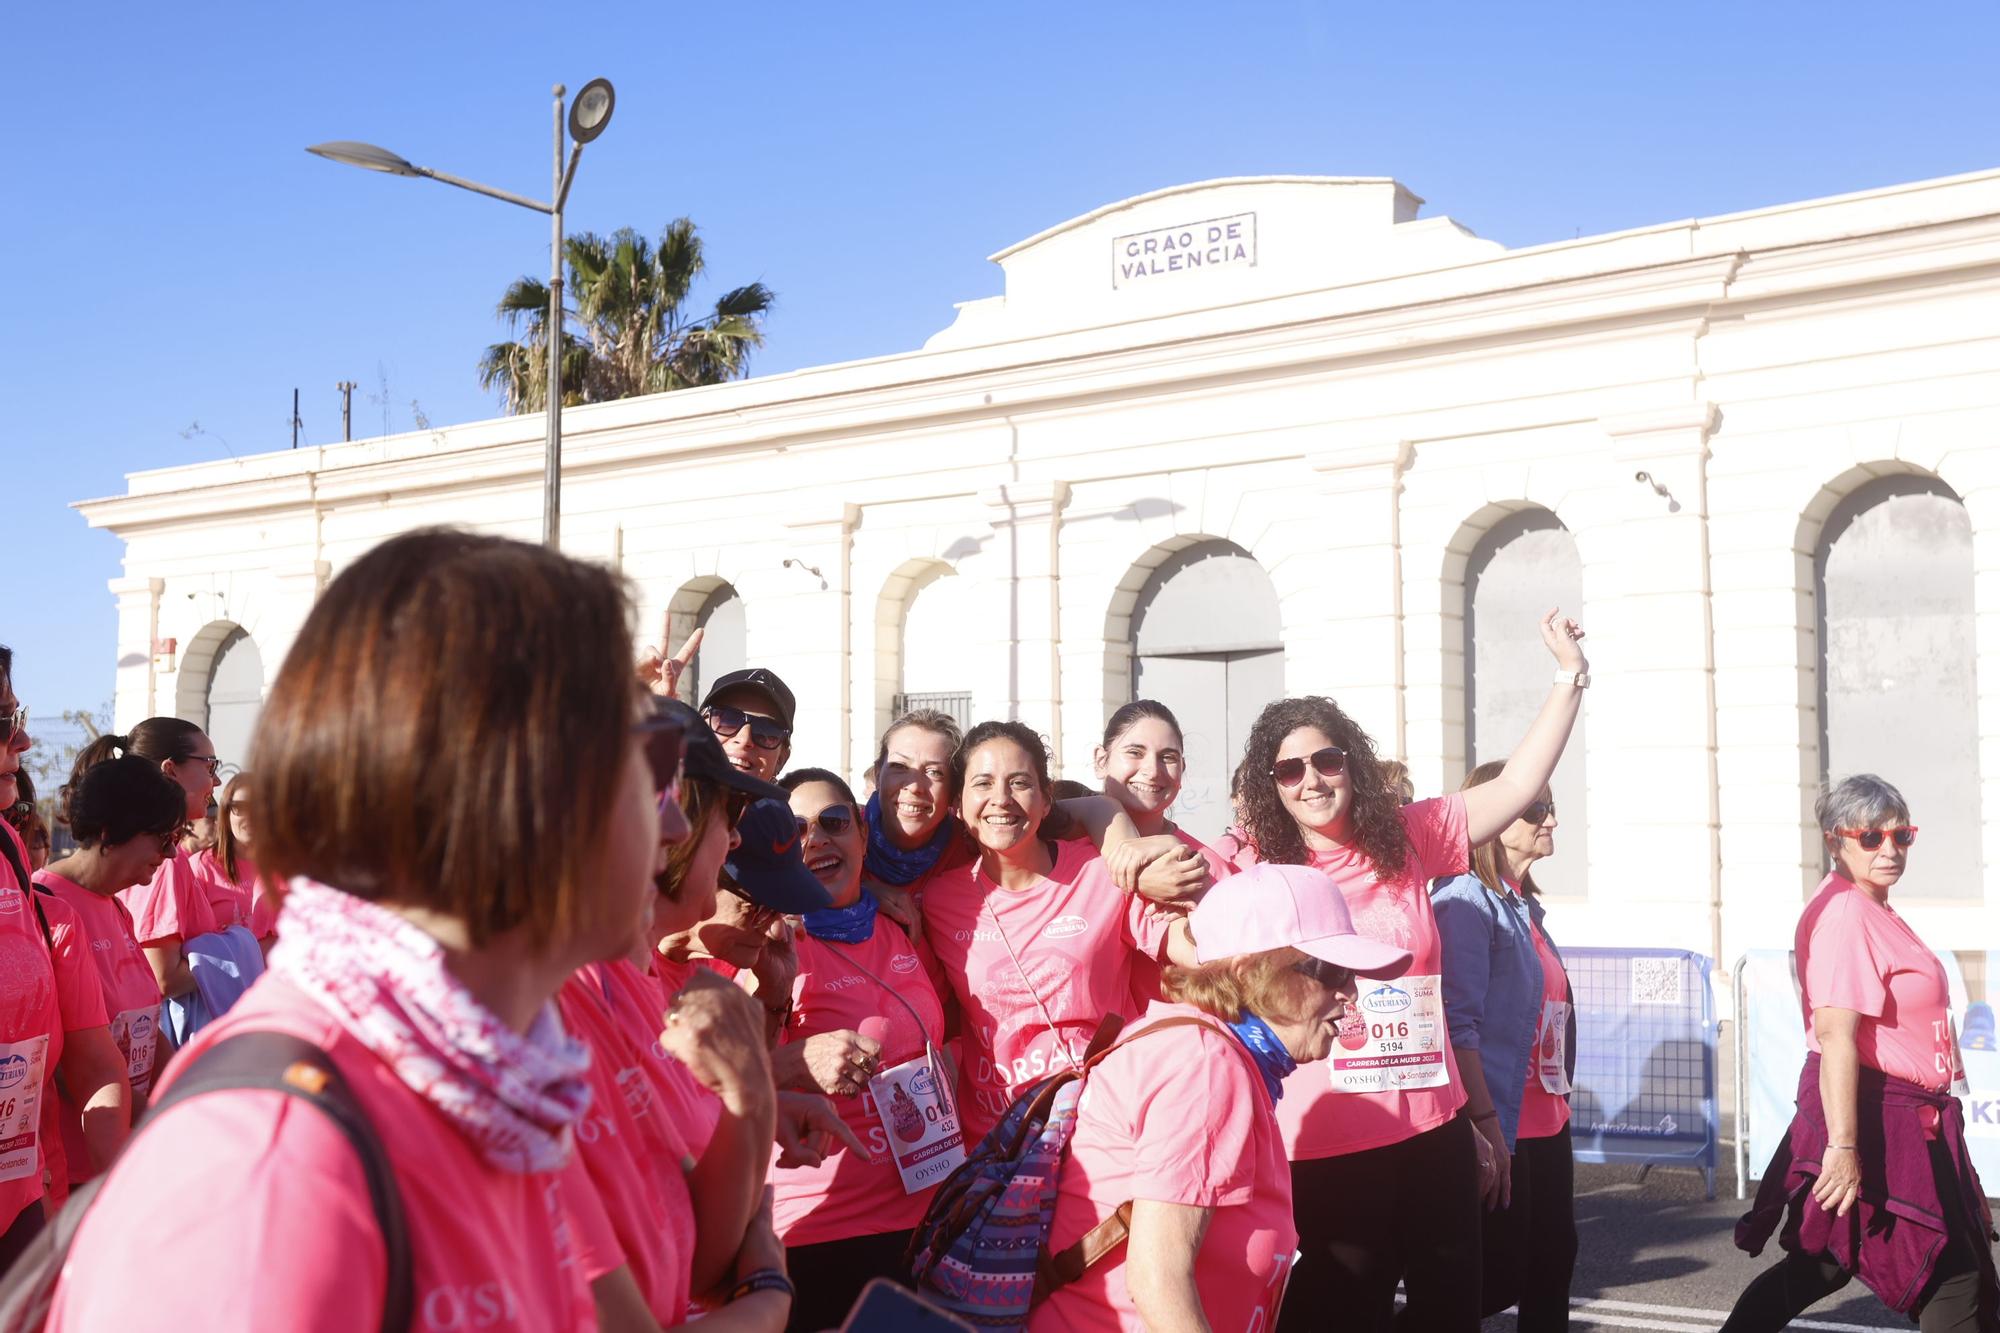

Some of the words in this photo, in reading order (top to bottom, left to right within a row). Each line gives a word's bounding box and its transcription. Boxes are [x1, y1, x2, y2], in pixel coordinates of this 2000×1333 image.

[1126, 232, 1192, 257] GRAO
[1208, 222, 1241, 243] DE
[1121, 244, 1246, 279] VALENCIA
[825, 975, 866, 992] OYSHO
[1414, 990, 1434, 998] SUMA
[1367, 998, 1409, 1009] ASTURIANA
[1371, 1021, 1409, 1039] 016
[132, 1045, 147, 1061] 016
[1380, 1041, 1404, 1053] 5194
[1346, 1060, 1380, 1068] CARRERA
[1390, 1057, 1399, 1065] LA
[1400, 1055, 1421, 1064] MUJER
[1343, 1073, 1382, 1085] OYSHO
[1407, 1071, 1439, 1080] Santander
[941, 1120, 955, 1133] 432
[912, 1144, 943, 1161] CARRERA
[943, 1139, 953, 1148] DE
[915, 1159, 950, 1181] OYSHO
